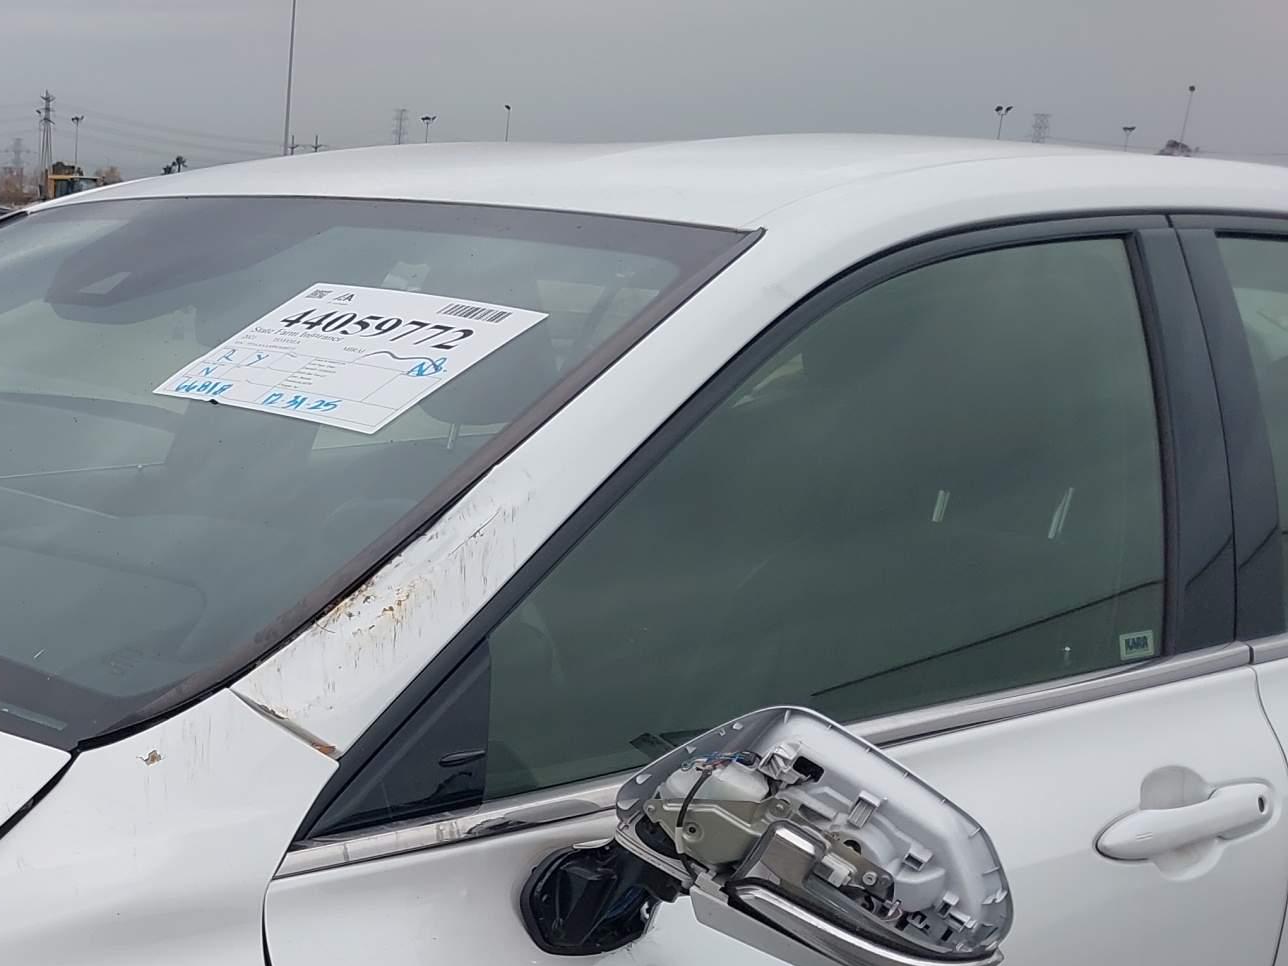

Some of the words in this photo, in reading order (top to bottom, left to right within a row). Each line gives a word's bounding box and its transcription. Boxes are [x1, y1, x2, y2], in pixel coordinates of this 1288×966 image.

[250, 327, 273, 335] State
[273, 328, 299, 337] Farm
[280, 308, 474, 350] 44059772
